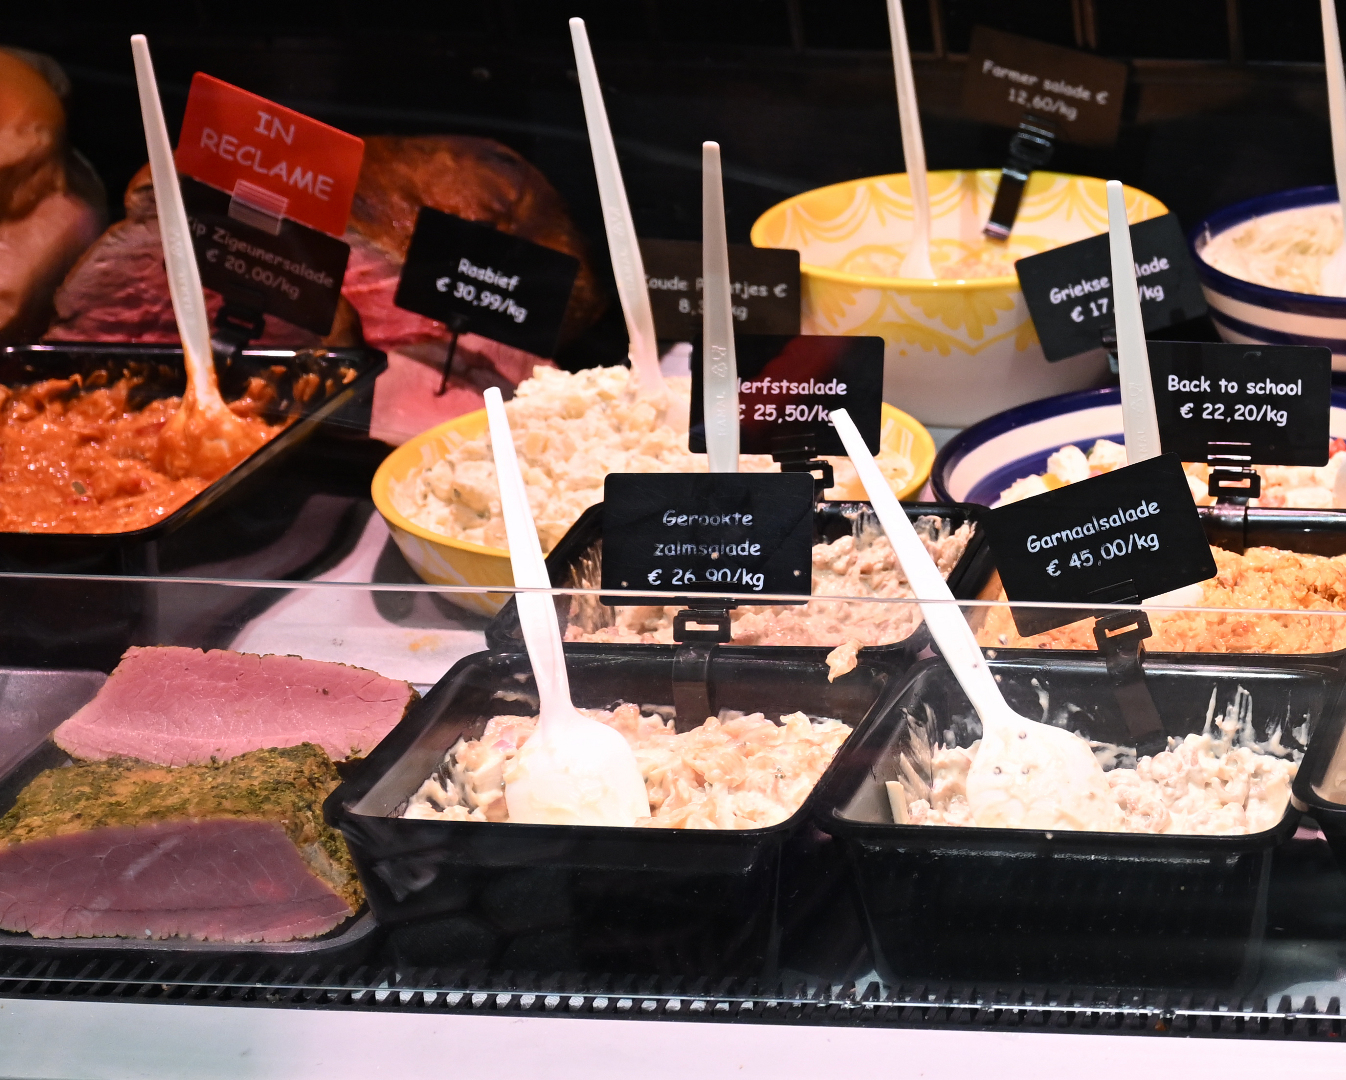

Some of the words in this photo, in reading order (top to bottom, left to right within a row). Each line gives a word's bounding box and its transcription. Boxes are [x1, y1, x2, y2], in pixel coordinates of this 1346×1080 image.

[254, 110, 296, 146] IN
[200, 127, 334, 201] RECLAME
[205, 249, 219, 263] €
[212, 226, 335, 288] Zigeunersalade
[435, 276, 451, 292] €
[457, 257, 521, 292] Rosbief
[1049, 275, 1111, 305] Griekse
[1070, 305, 1085, 323] €
[1167, 374, 1211, 393] Back
[1219, 377, 1238, 394] to
[1246, 377, 1302, 397] school
[1180, 402, 1194, 419] €
[1201, 403, 1288, 427] 22,20/kg
[662, 509, 753, 527] Gerookte
[1026, 500, 1161, 553] Garnaalsalade
[653, 538, 762, 558] zalmsalade
[1045, 558, 1062, 577] €
[1068, 531, 1160, 571] 45,00/kg
[647, 568, 663, 586] €
[671, 568, 765, 591] 2690/kg
